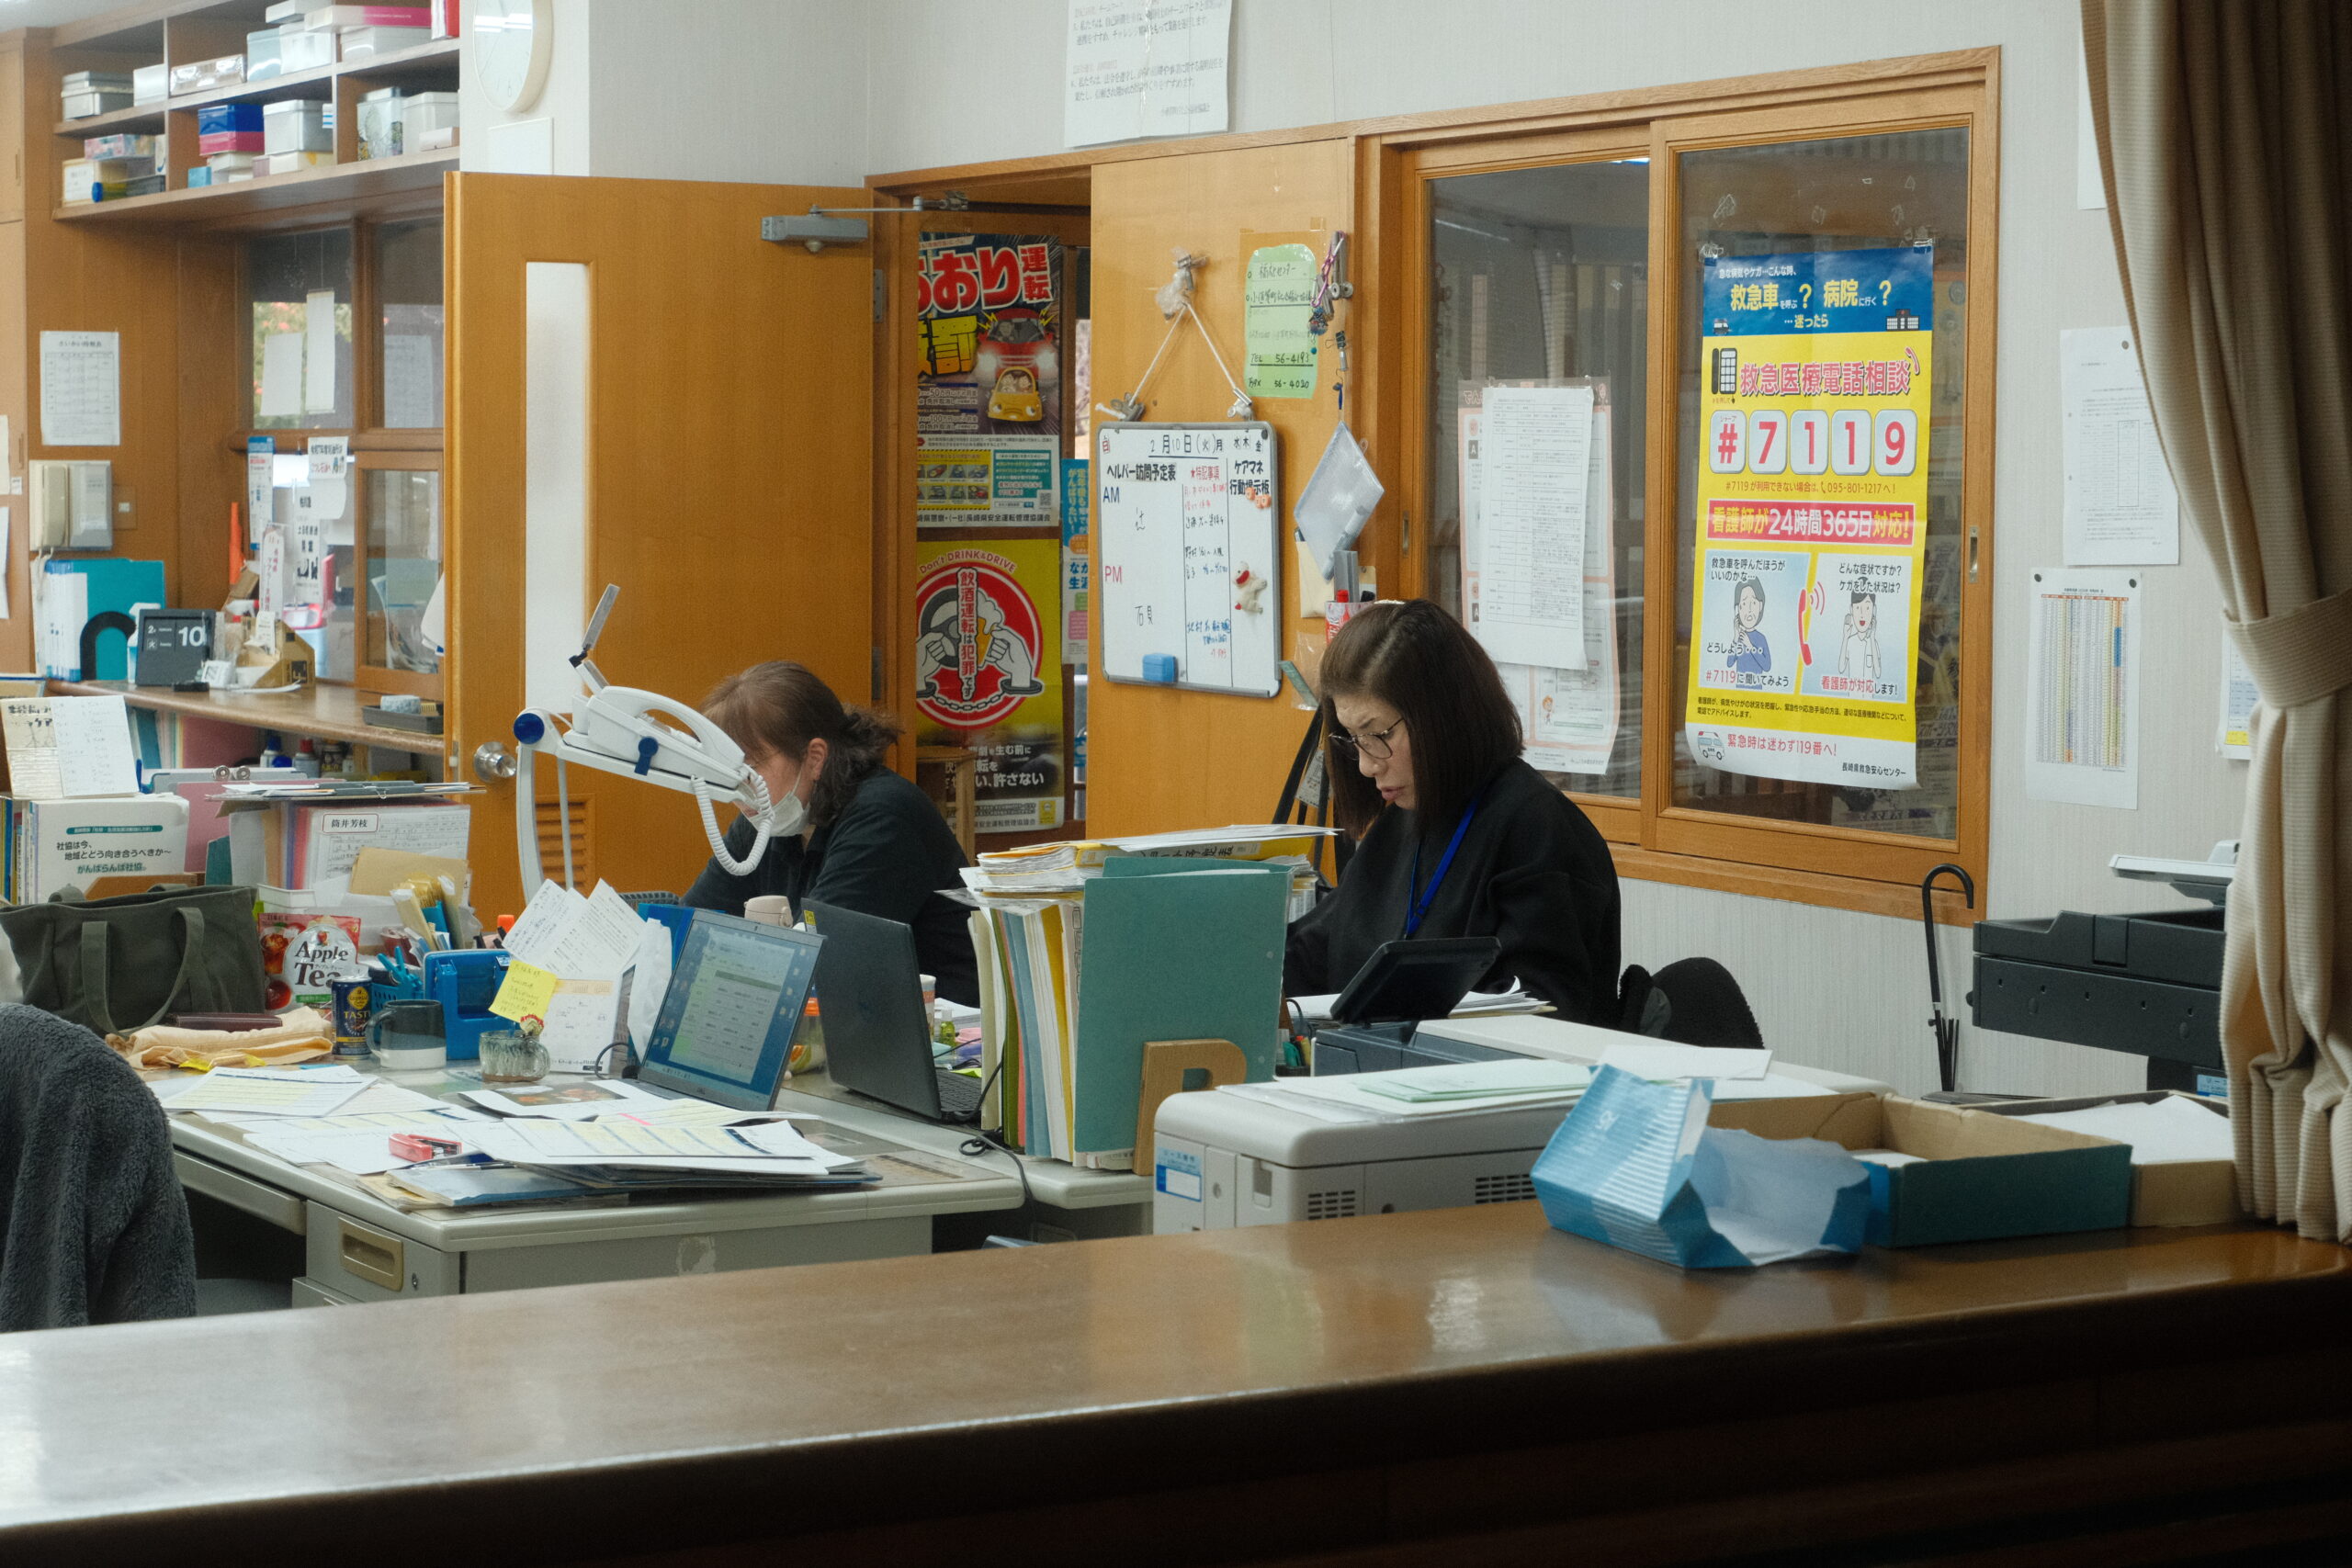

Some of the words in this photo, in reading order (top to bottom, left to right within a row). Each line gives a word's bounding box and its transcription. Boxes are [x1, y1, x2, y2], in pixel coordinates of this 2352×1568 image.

[1250, 354, 1263, 363] TEL
[1739, 360, 1910, 396] 救急医療電話相談
[1235, 460, 1264, 475] ケアマネ
[1103, 487, 1120, 503] AM
[1713, 505, 1909, 538] 看護師が24時間365日対応！
[920, 556, 945, 573] Don't
[1712, 558, 1785, 570] 救急車を呼んだほうが
[1838, 562, 1902, 575] どんな症状ですか？
[1104, 566, 1123, 583] PM
[1839, 580, 1901, 593] ケガをした状況は？
[178, 626, 207, 647] 10
[960, 572, 975, 697] 飲酒運転は犯罪です
[1706, 670, 1789, 687] #7119に聞いてみよう
[1821, 676, 1897, 695] 看護師が対応します！
[1727, 733, 1837, 756] 緊急時は迷わず119番へ！
[1842, 762, 1906, 776] 長崎県救急安心センター
[57, 840, 93, 851] 社協は今、
[295, 941, 349, 963] Apple
